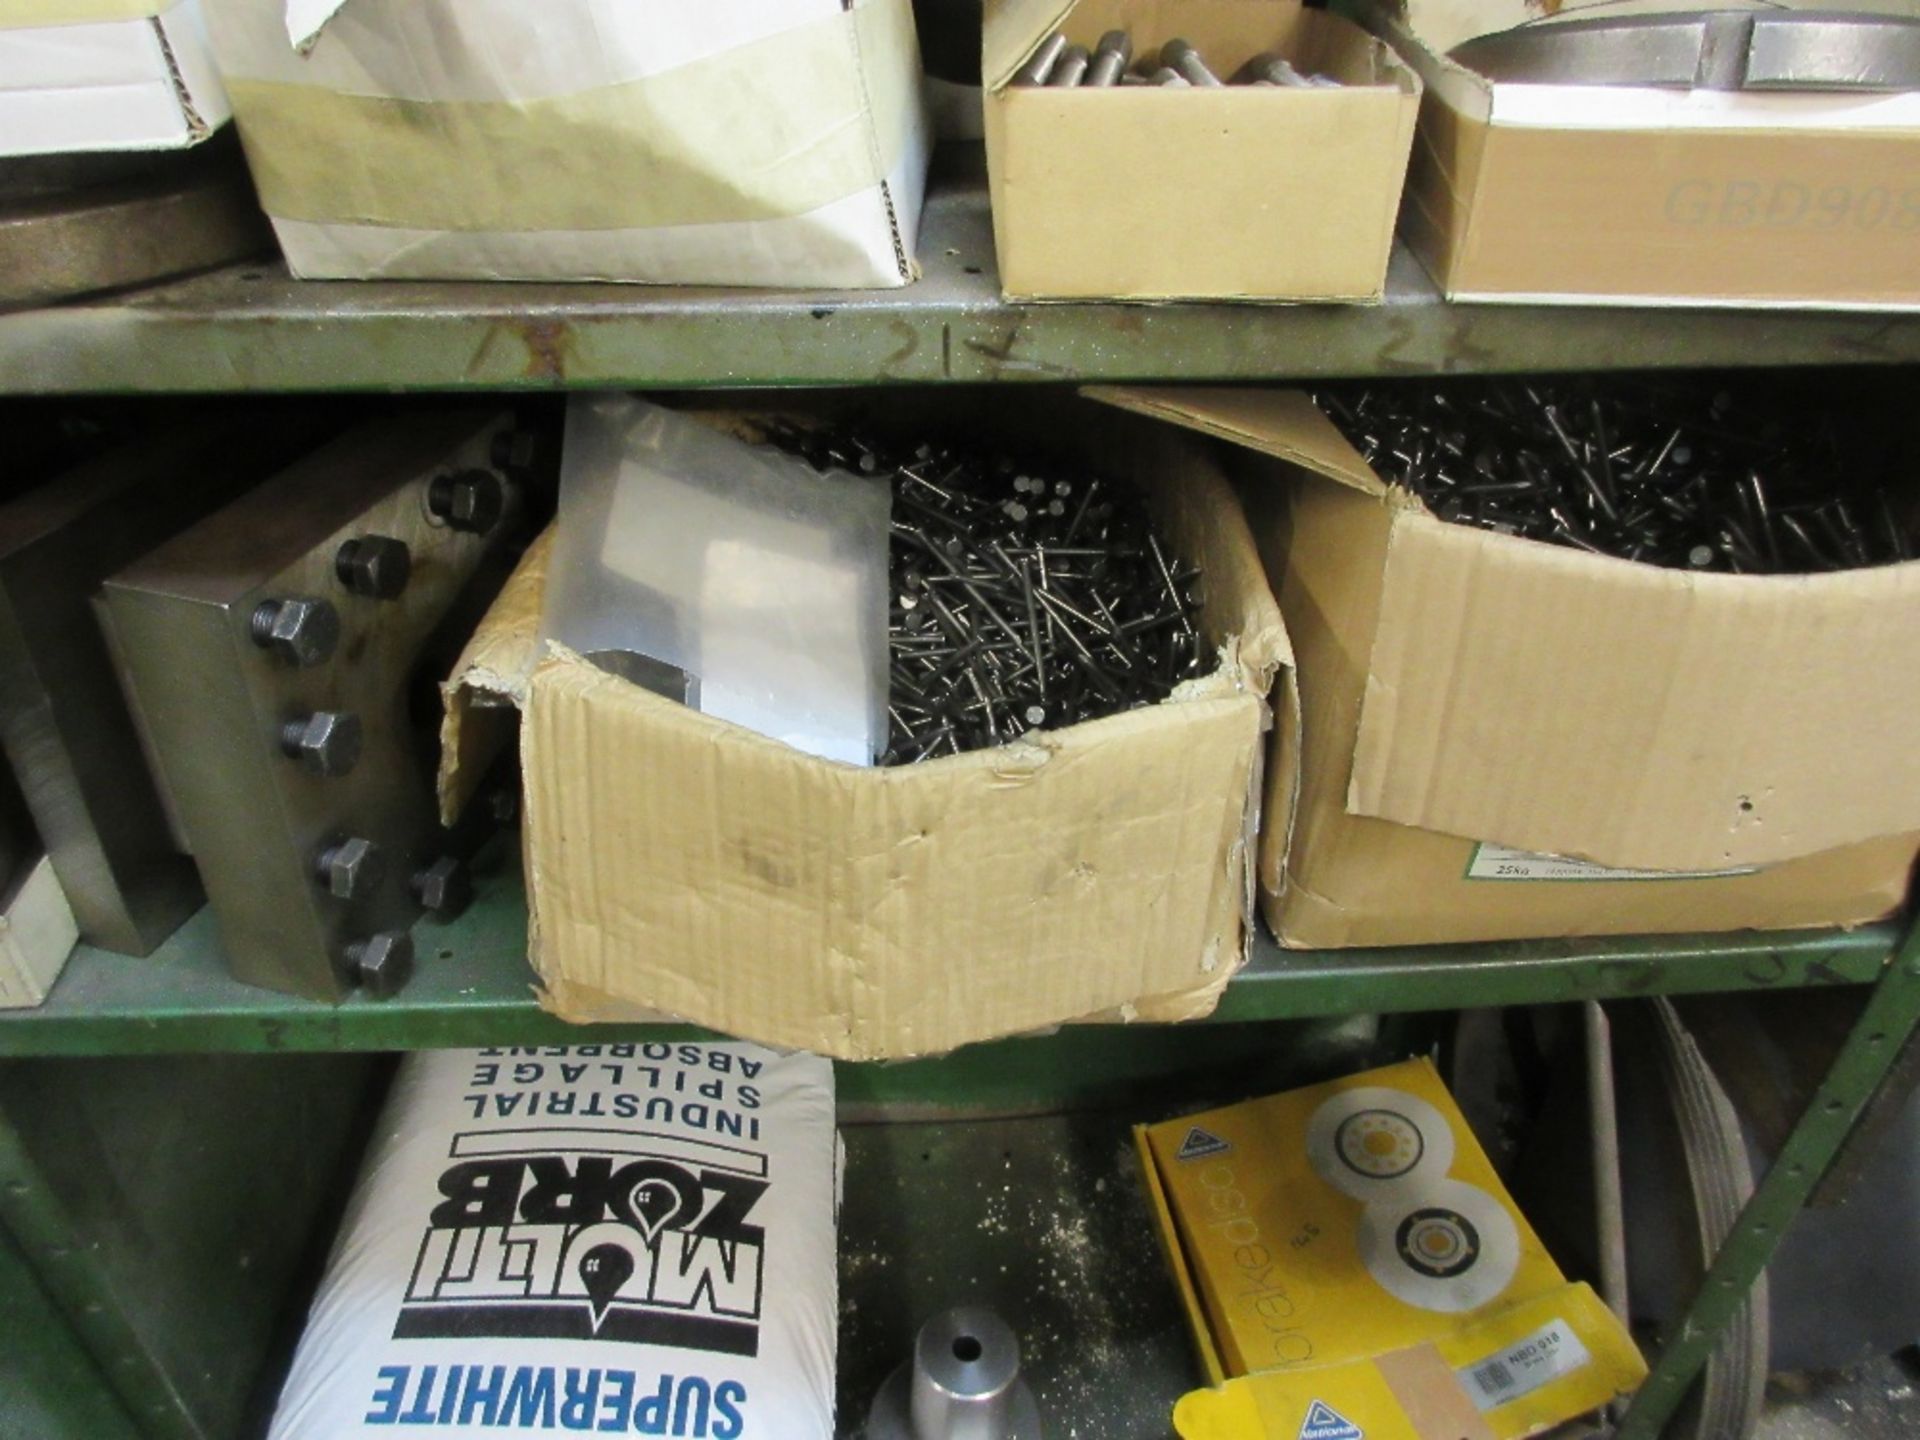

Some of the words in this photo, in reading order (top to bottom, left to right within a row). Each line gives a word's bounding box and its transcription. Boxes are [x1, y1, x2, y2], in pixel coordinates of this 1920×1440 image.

[463, 1091, 761, 1140] INDUSTRIAL
[470, 1063, 761, 1109] SPILLAGE
[429, 1156, 771, 1234] ZORB
[404, 1222, 765, 1319] MULTI
[364, 1364, 747, 1440] SUPERWHITE
